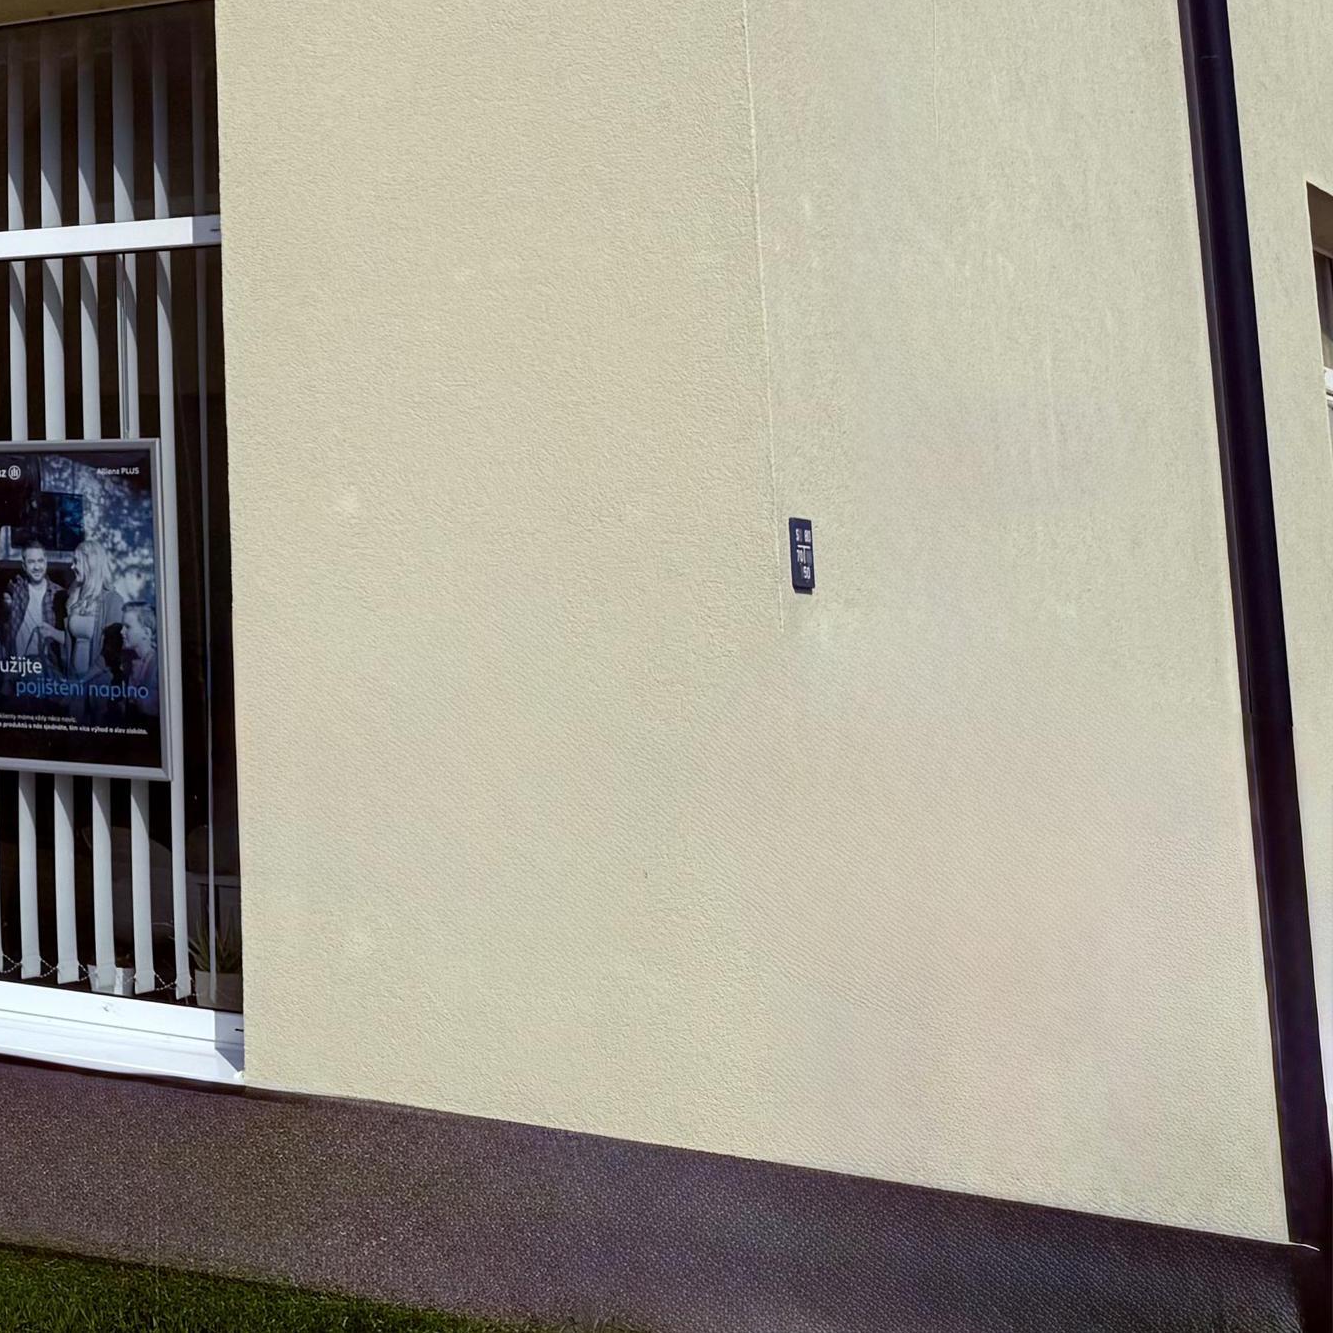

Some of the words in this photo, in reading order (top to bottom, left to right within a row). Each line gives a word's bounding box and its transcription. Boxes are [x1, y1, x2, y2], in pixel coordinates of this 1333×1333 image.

[121, 467, 140, 475] PLUS
[16, 677, 84, 698] pojištění
[88, 680, 149, 700] naplno
